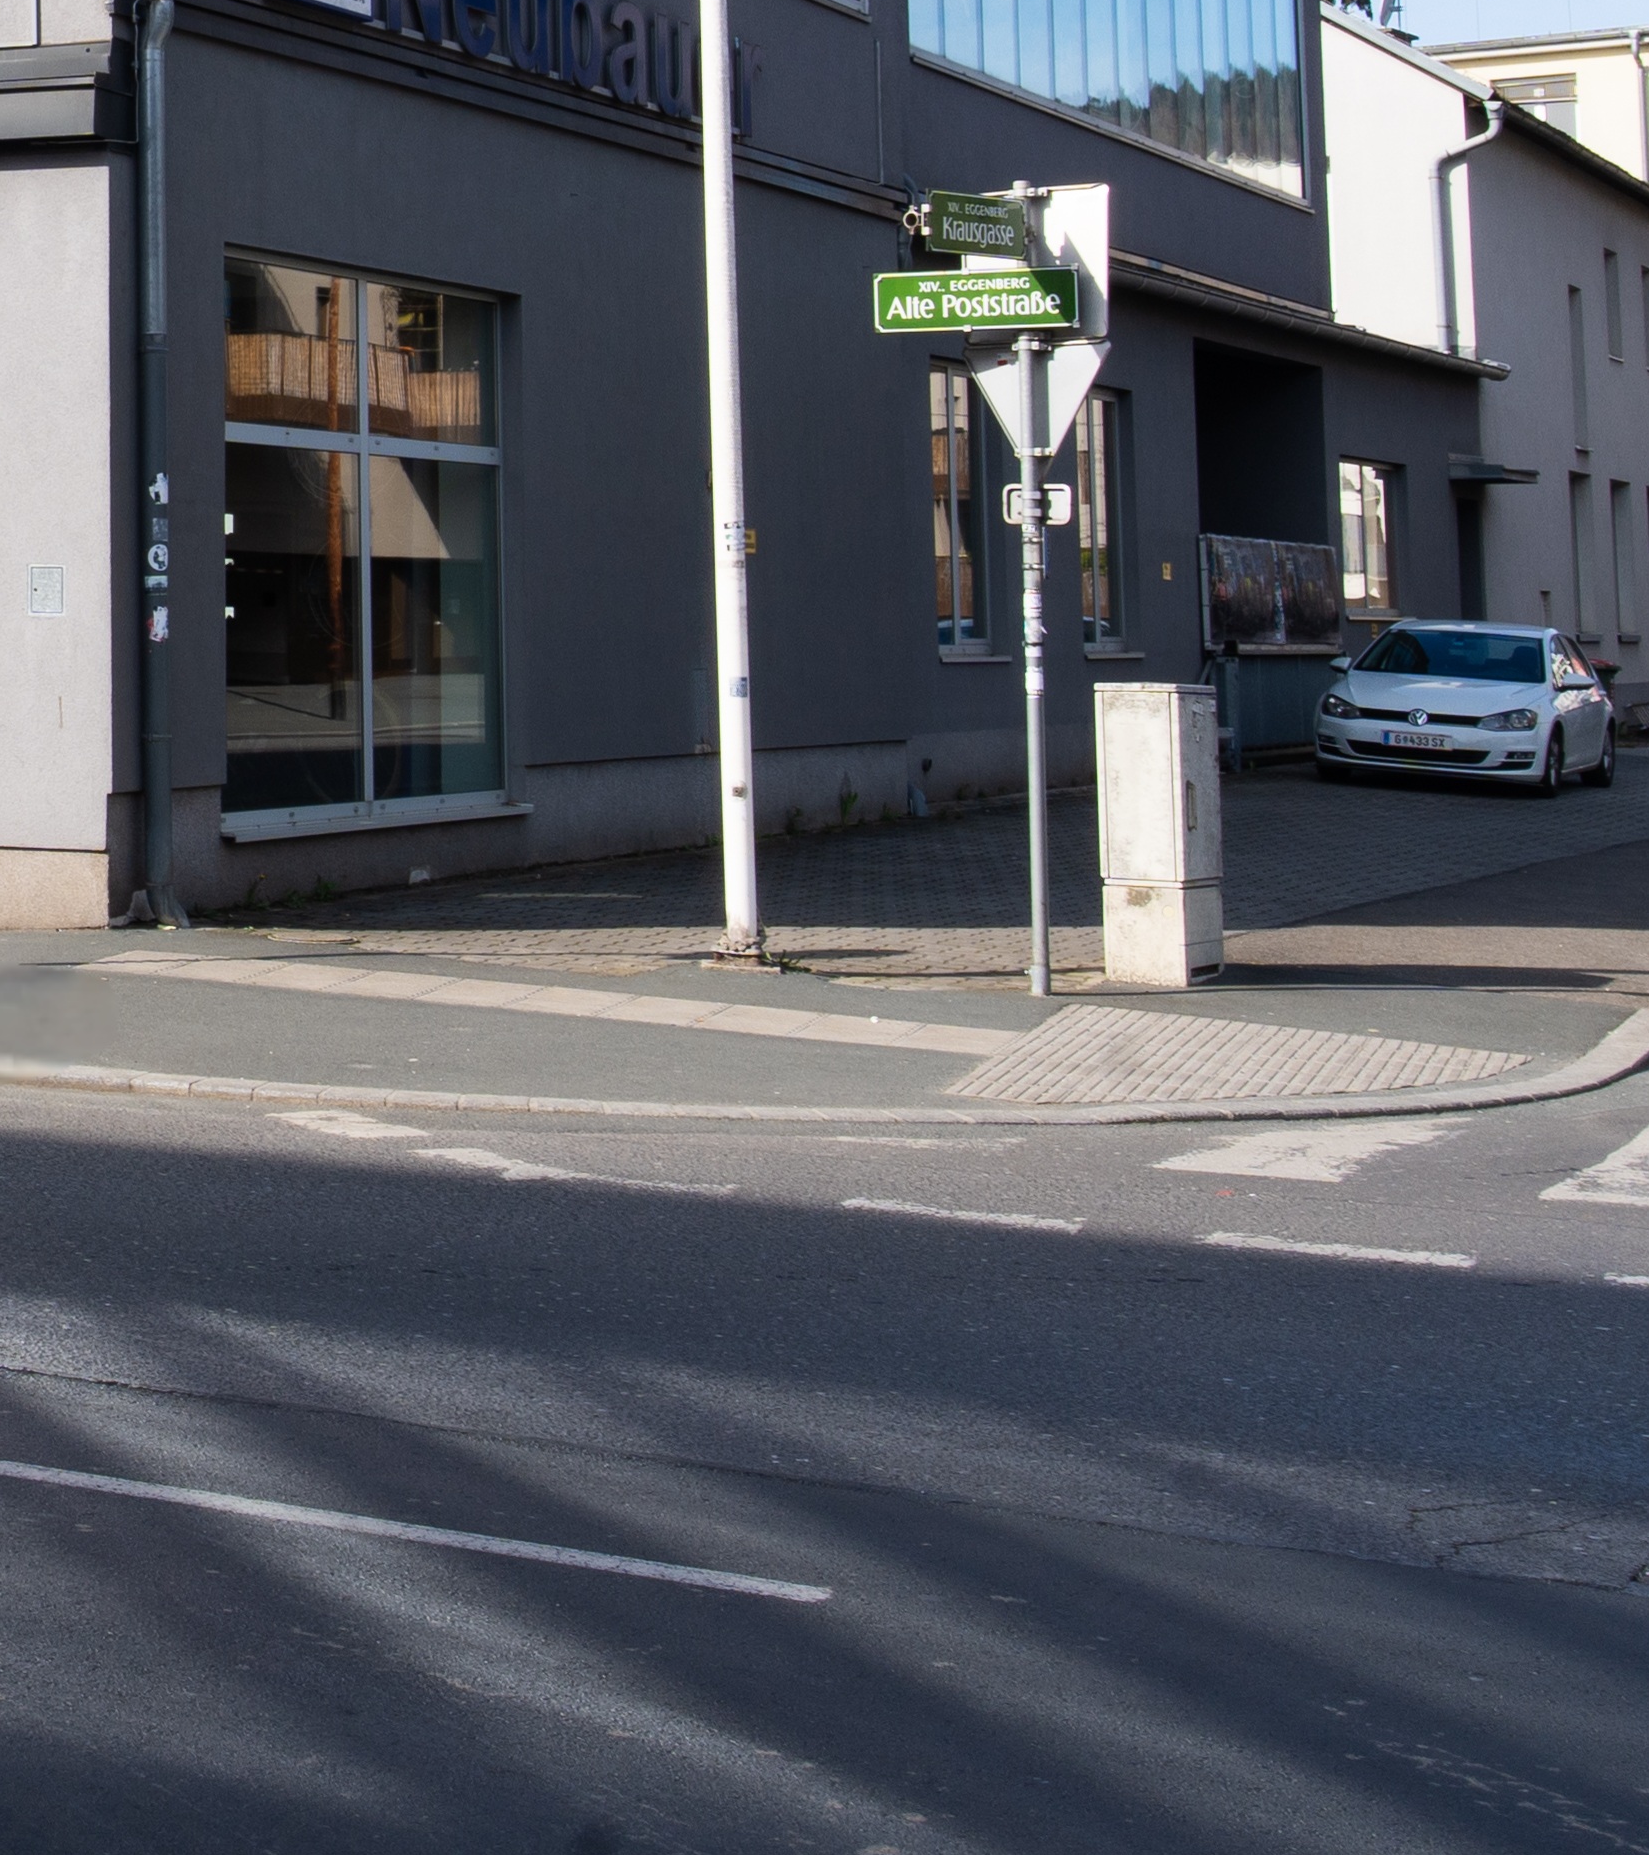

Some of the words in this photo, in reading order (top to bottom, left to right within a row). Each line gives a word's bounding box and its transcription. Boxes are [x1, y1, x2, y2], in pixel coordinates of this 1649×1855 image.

[965, 203, 1008, 219] EGGENBERG
[942, 216, 1014, 248] Krausgasse
[949, 277, 1030, 292] EGGENBERG
[886, 296, 935, 320] Alte
[942, 290, 1061, 318] Poststraße
[1394, 734, 1402, 744] G
[1409, 735, 1430, 747] 433
[1431, 738, 1445, 748] SX
